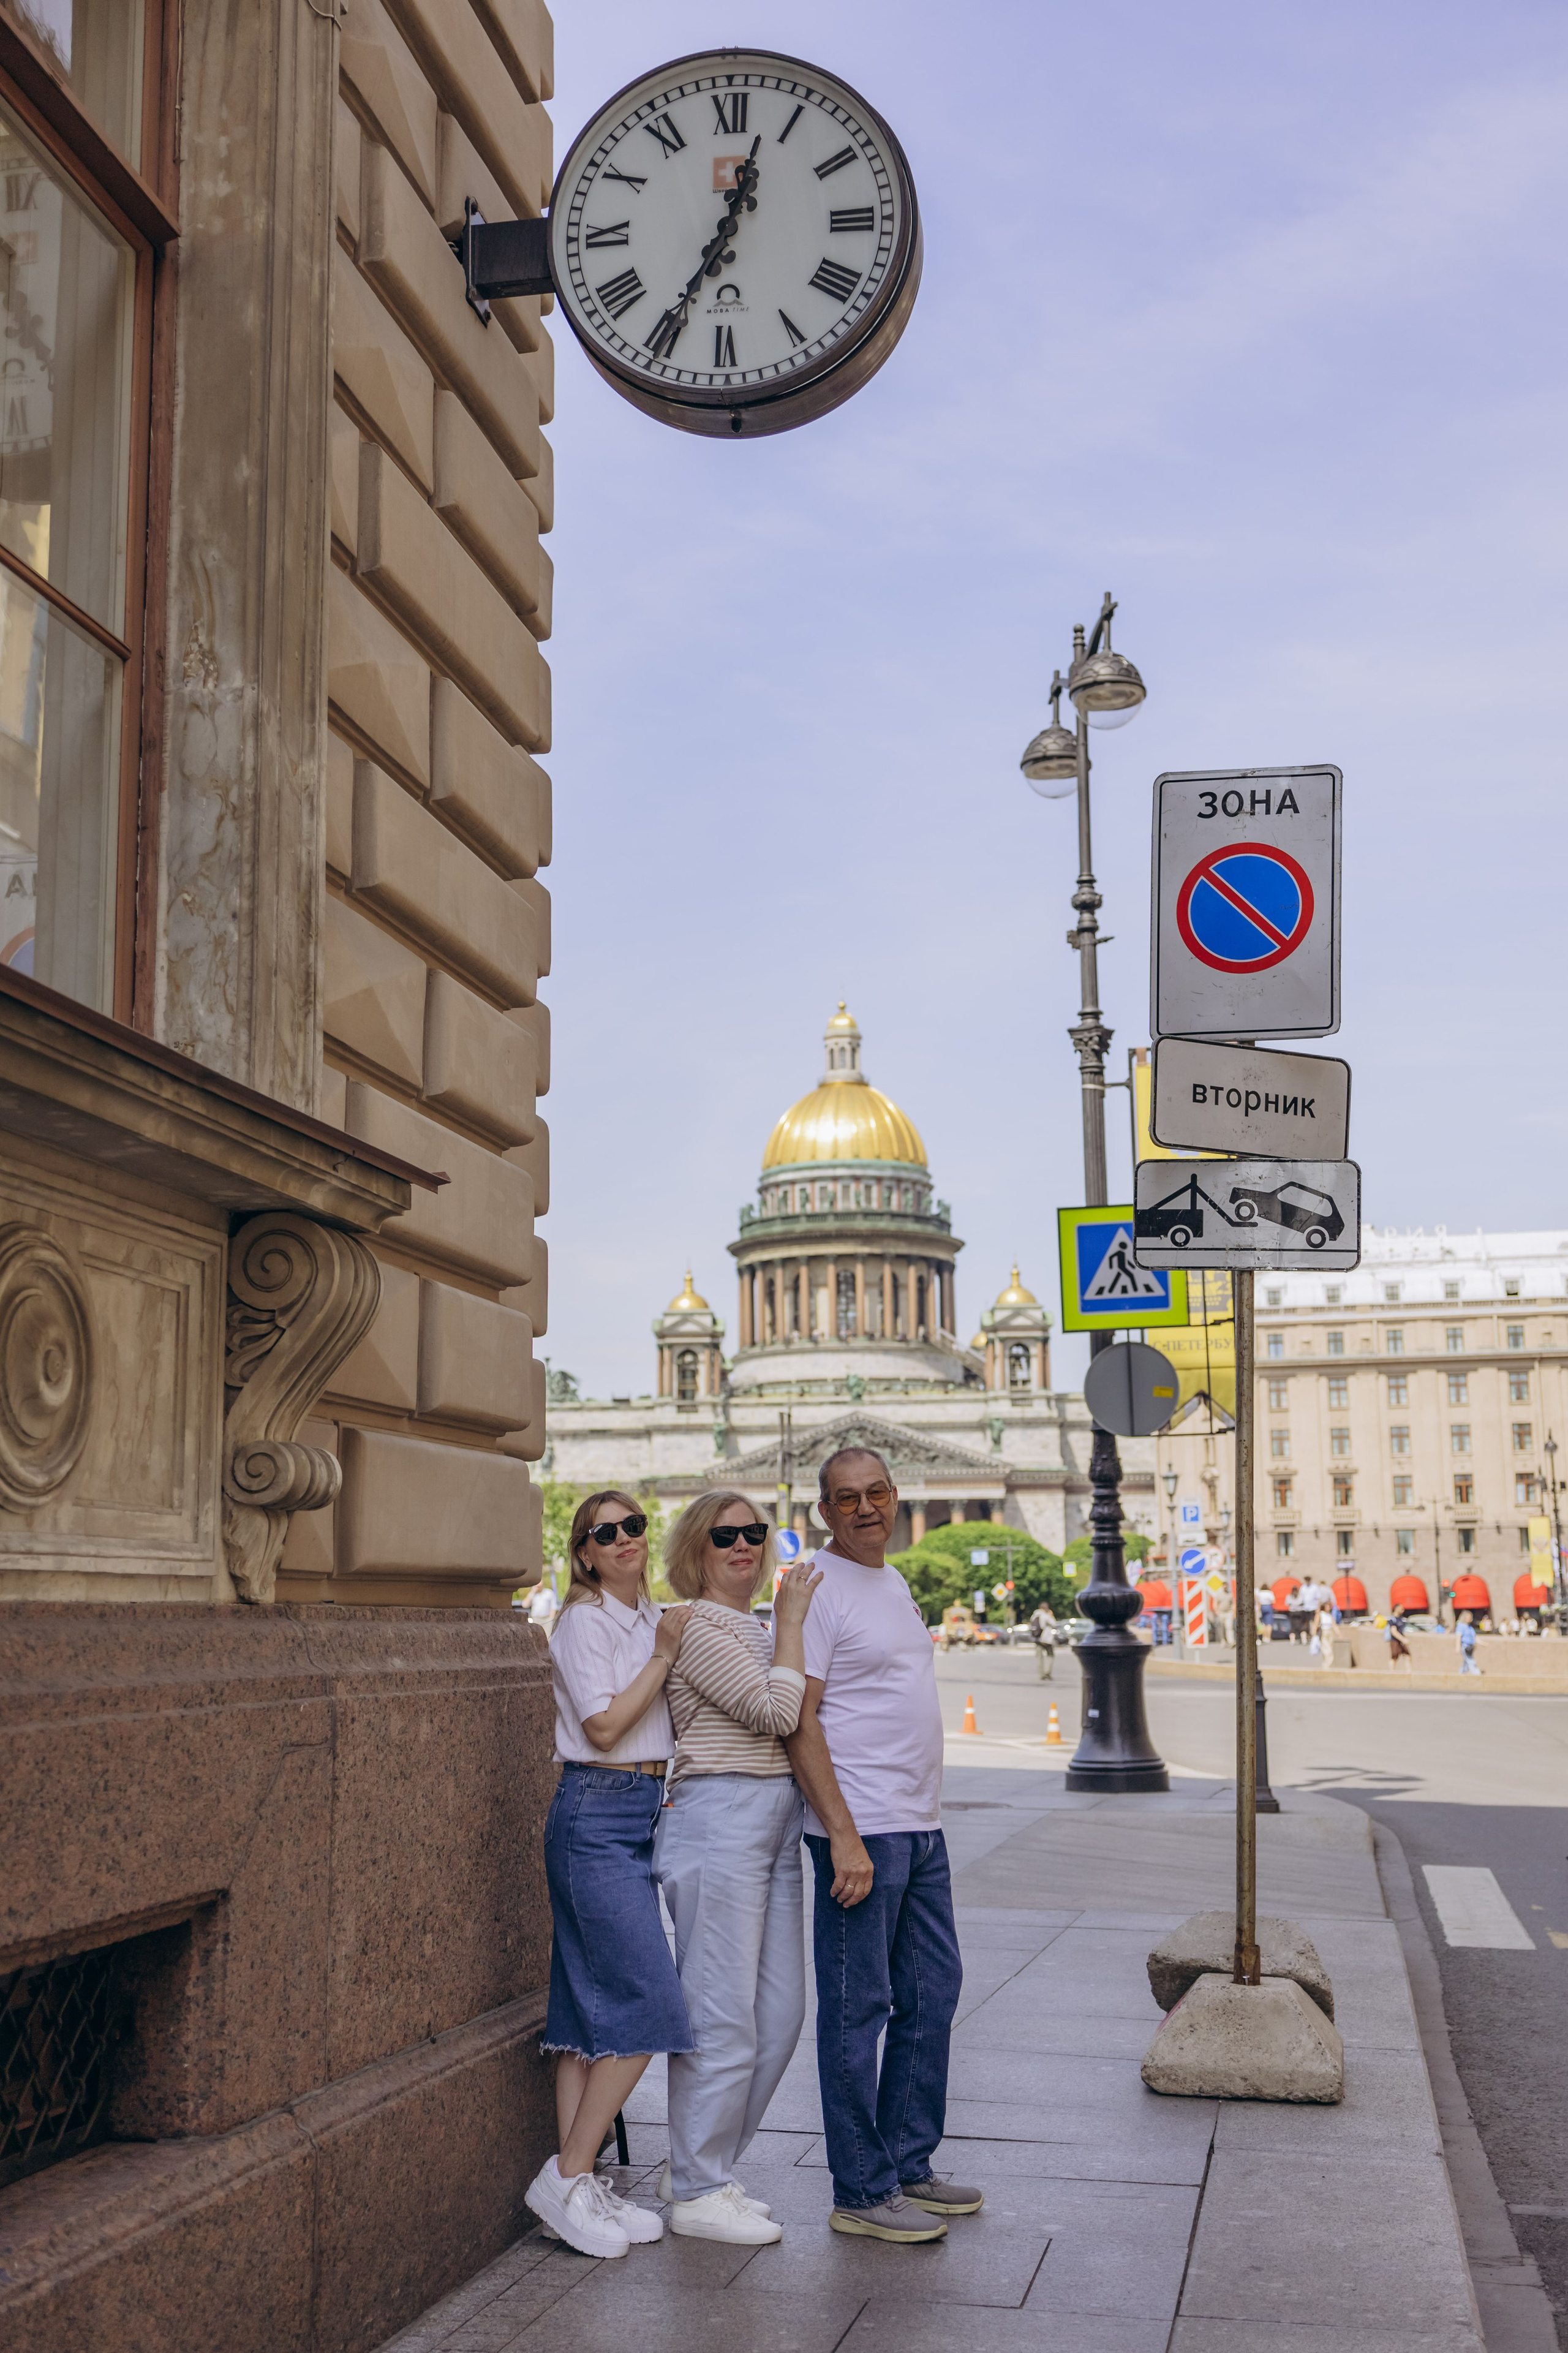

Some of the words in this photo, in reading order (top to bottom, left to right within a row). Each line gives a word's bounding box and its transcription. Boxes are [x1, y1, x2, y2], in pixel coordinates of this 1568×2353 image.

[710, 93, 750, 135] XII
[643, 111, 687, 159] XI
[601, 162, 648, 194] X
[813, 145, 859, 181] II
[586, 220, 630, 250] IX
[830, 206, 875, 233] III
[595, 266, 647, 322] VIII
[808, 257, 862, 305] IIII
[713, 325, 738, 368] VI
[778, 309, 807, 348] V
[1196, 787, 1301, 819] ЗОНА
[1191, 1082, 1317, 1119] вторник
